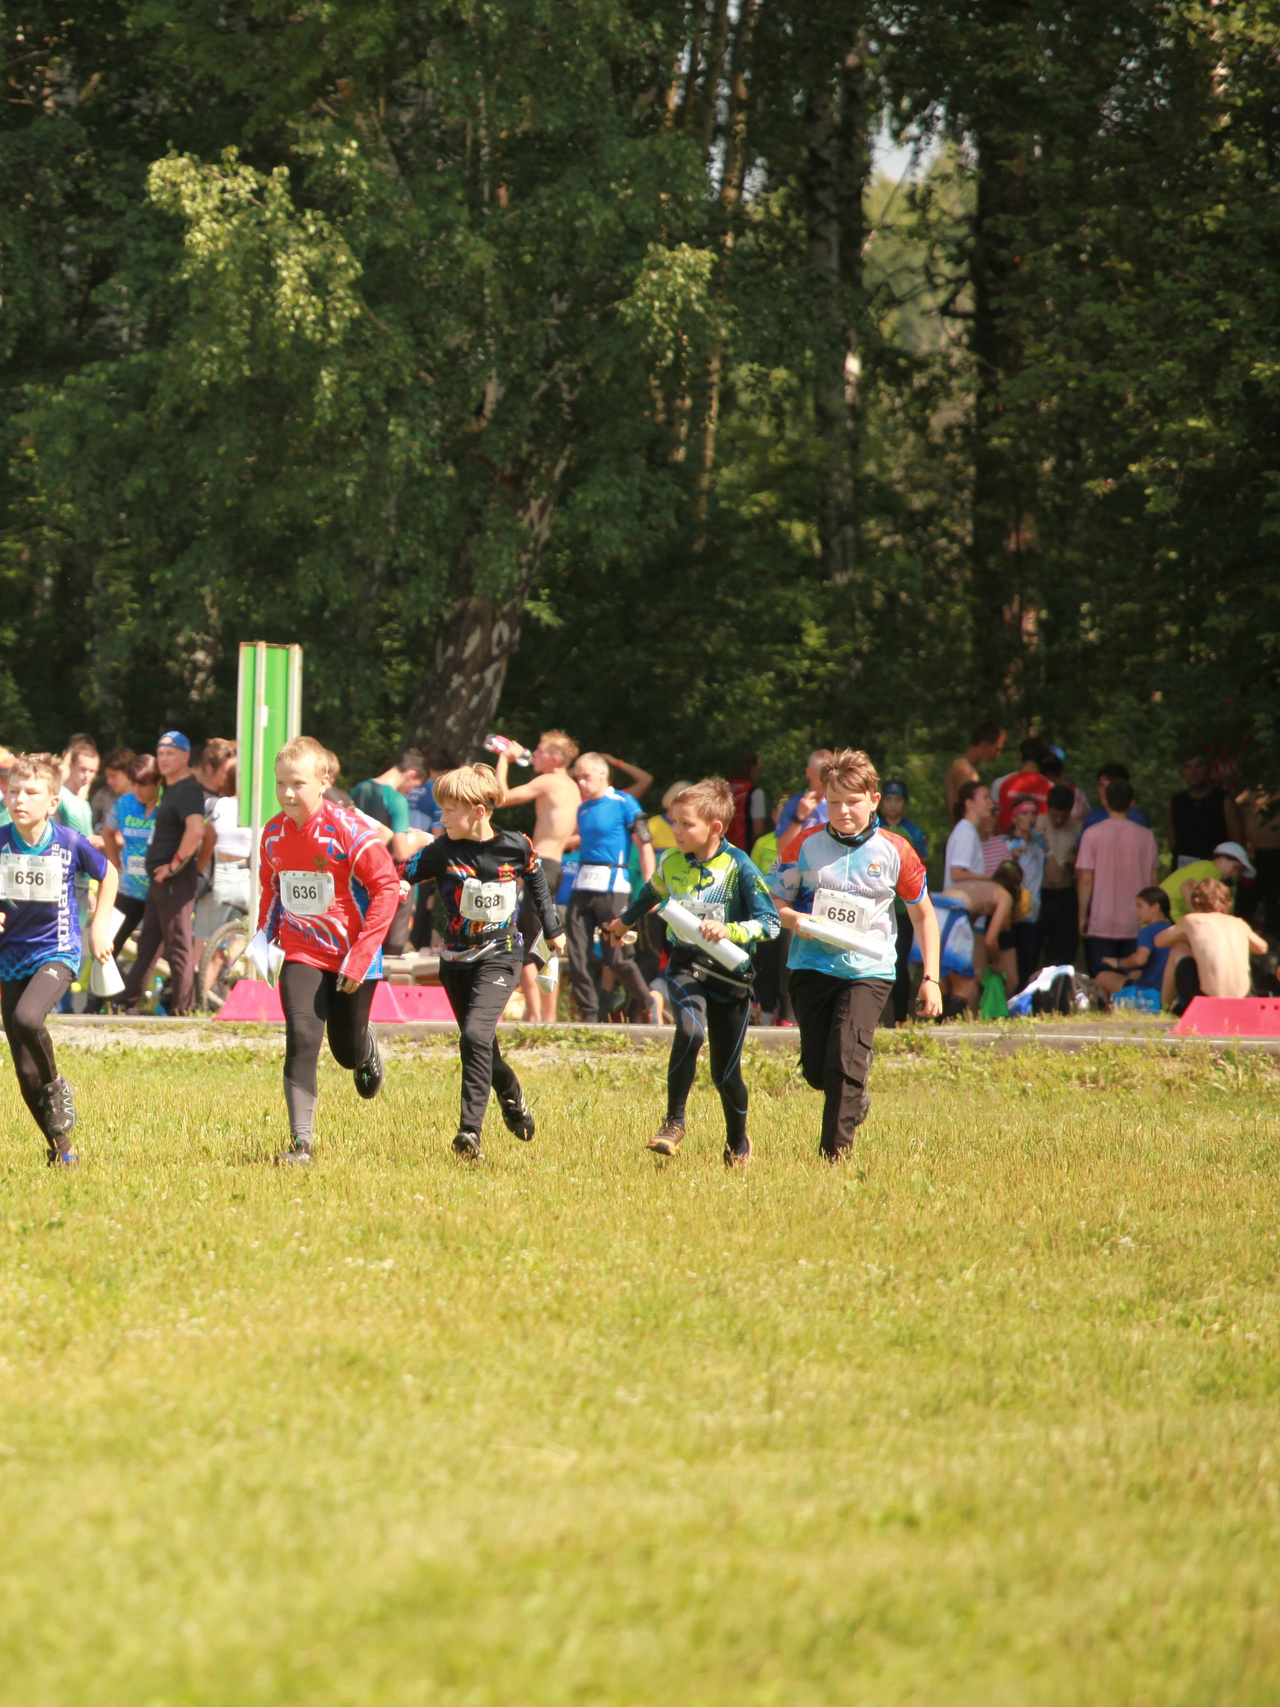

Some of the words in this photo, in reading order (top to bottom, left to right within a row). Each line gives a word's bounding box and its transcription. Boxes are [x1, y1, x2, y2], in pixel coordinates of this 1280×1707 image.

[15, 871, 44, 886] 656
[292, 885, 317, 900] 636
[474, 894, 500, 909] 638
[827, 906, 856, 924] 658
